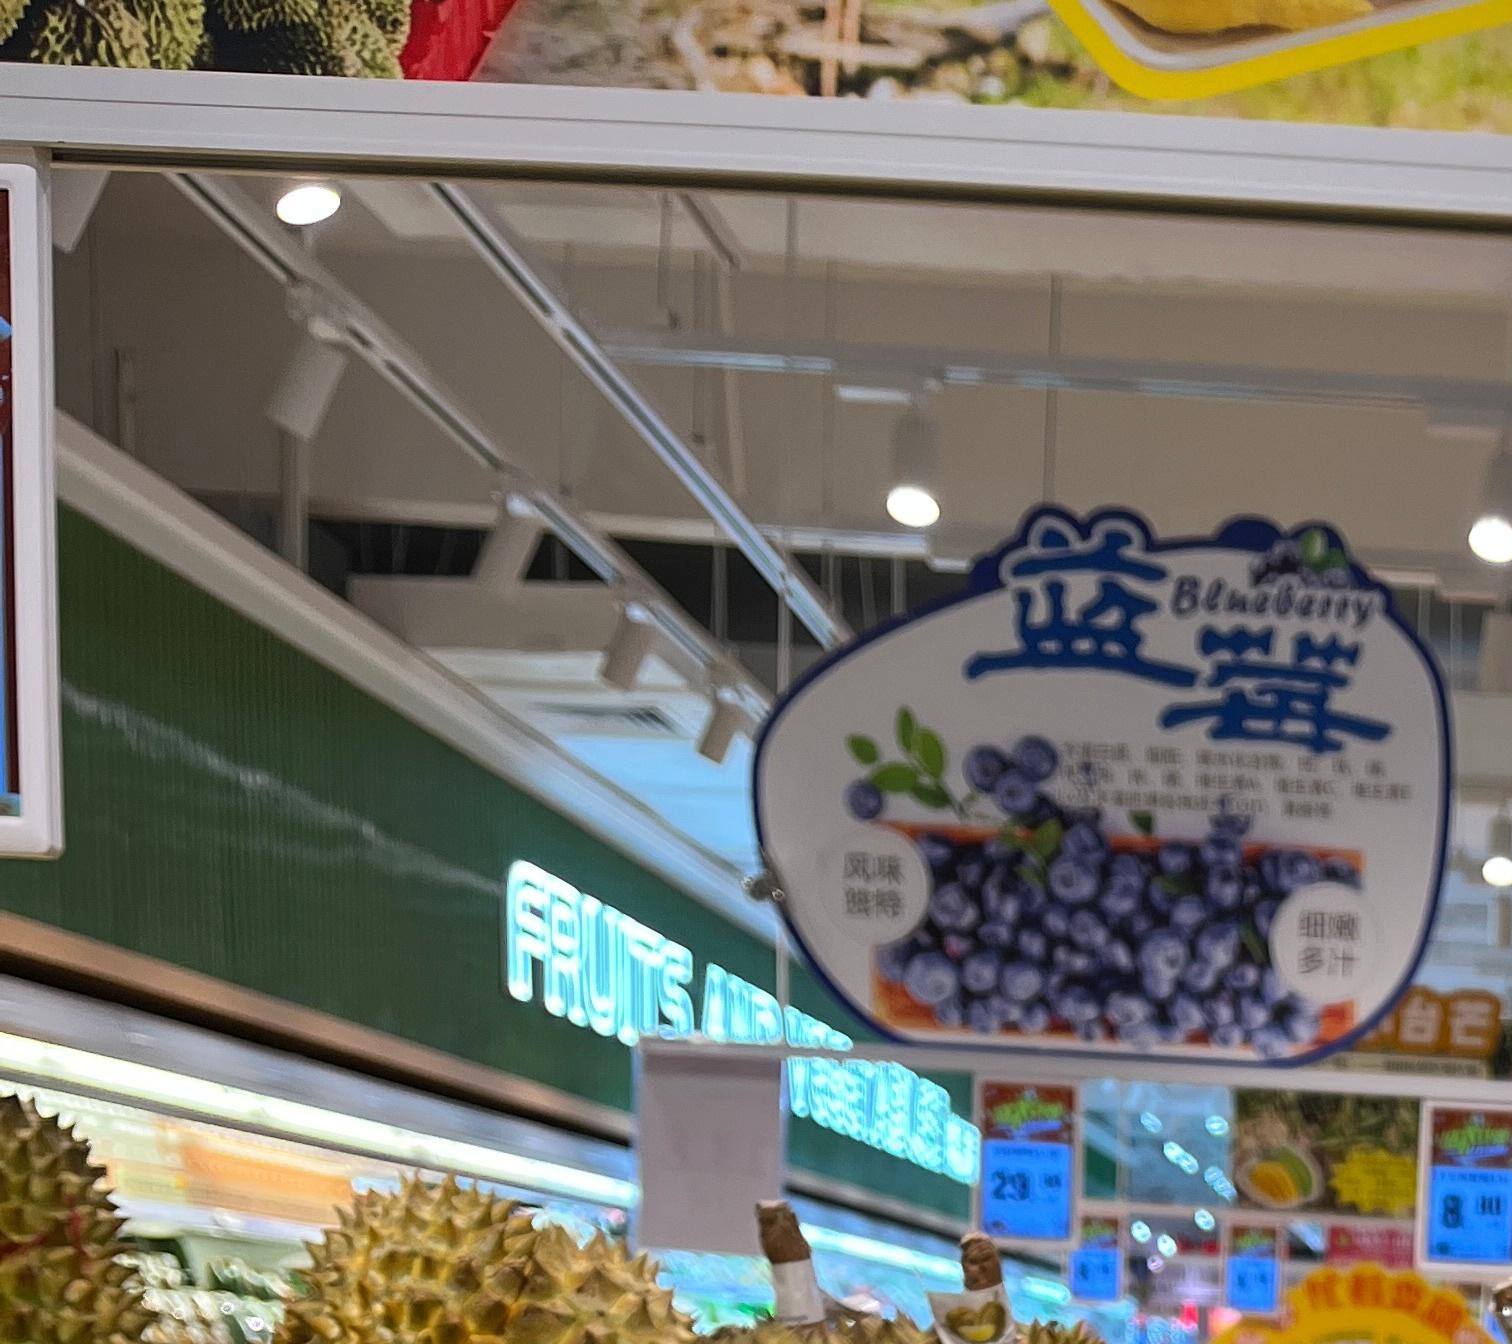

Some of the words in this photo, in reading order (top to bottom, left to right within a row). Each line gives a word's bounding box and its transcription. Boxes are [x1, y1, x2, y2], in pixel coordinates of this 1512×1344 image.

[965, 512, 1392, 754] 蓝莓
[1171, 575, 1372, 628] Blueberry
[507, 859, 694, 1046] FRUITS
[1299, 947, 1361, 978] 多汁
